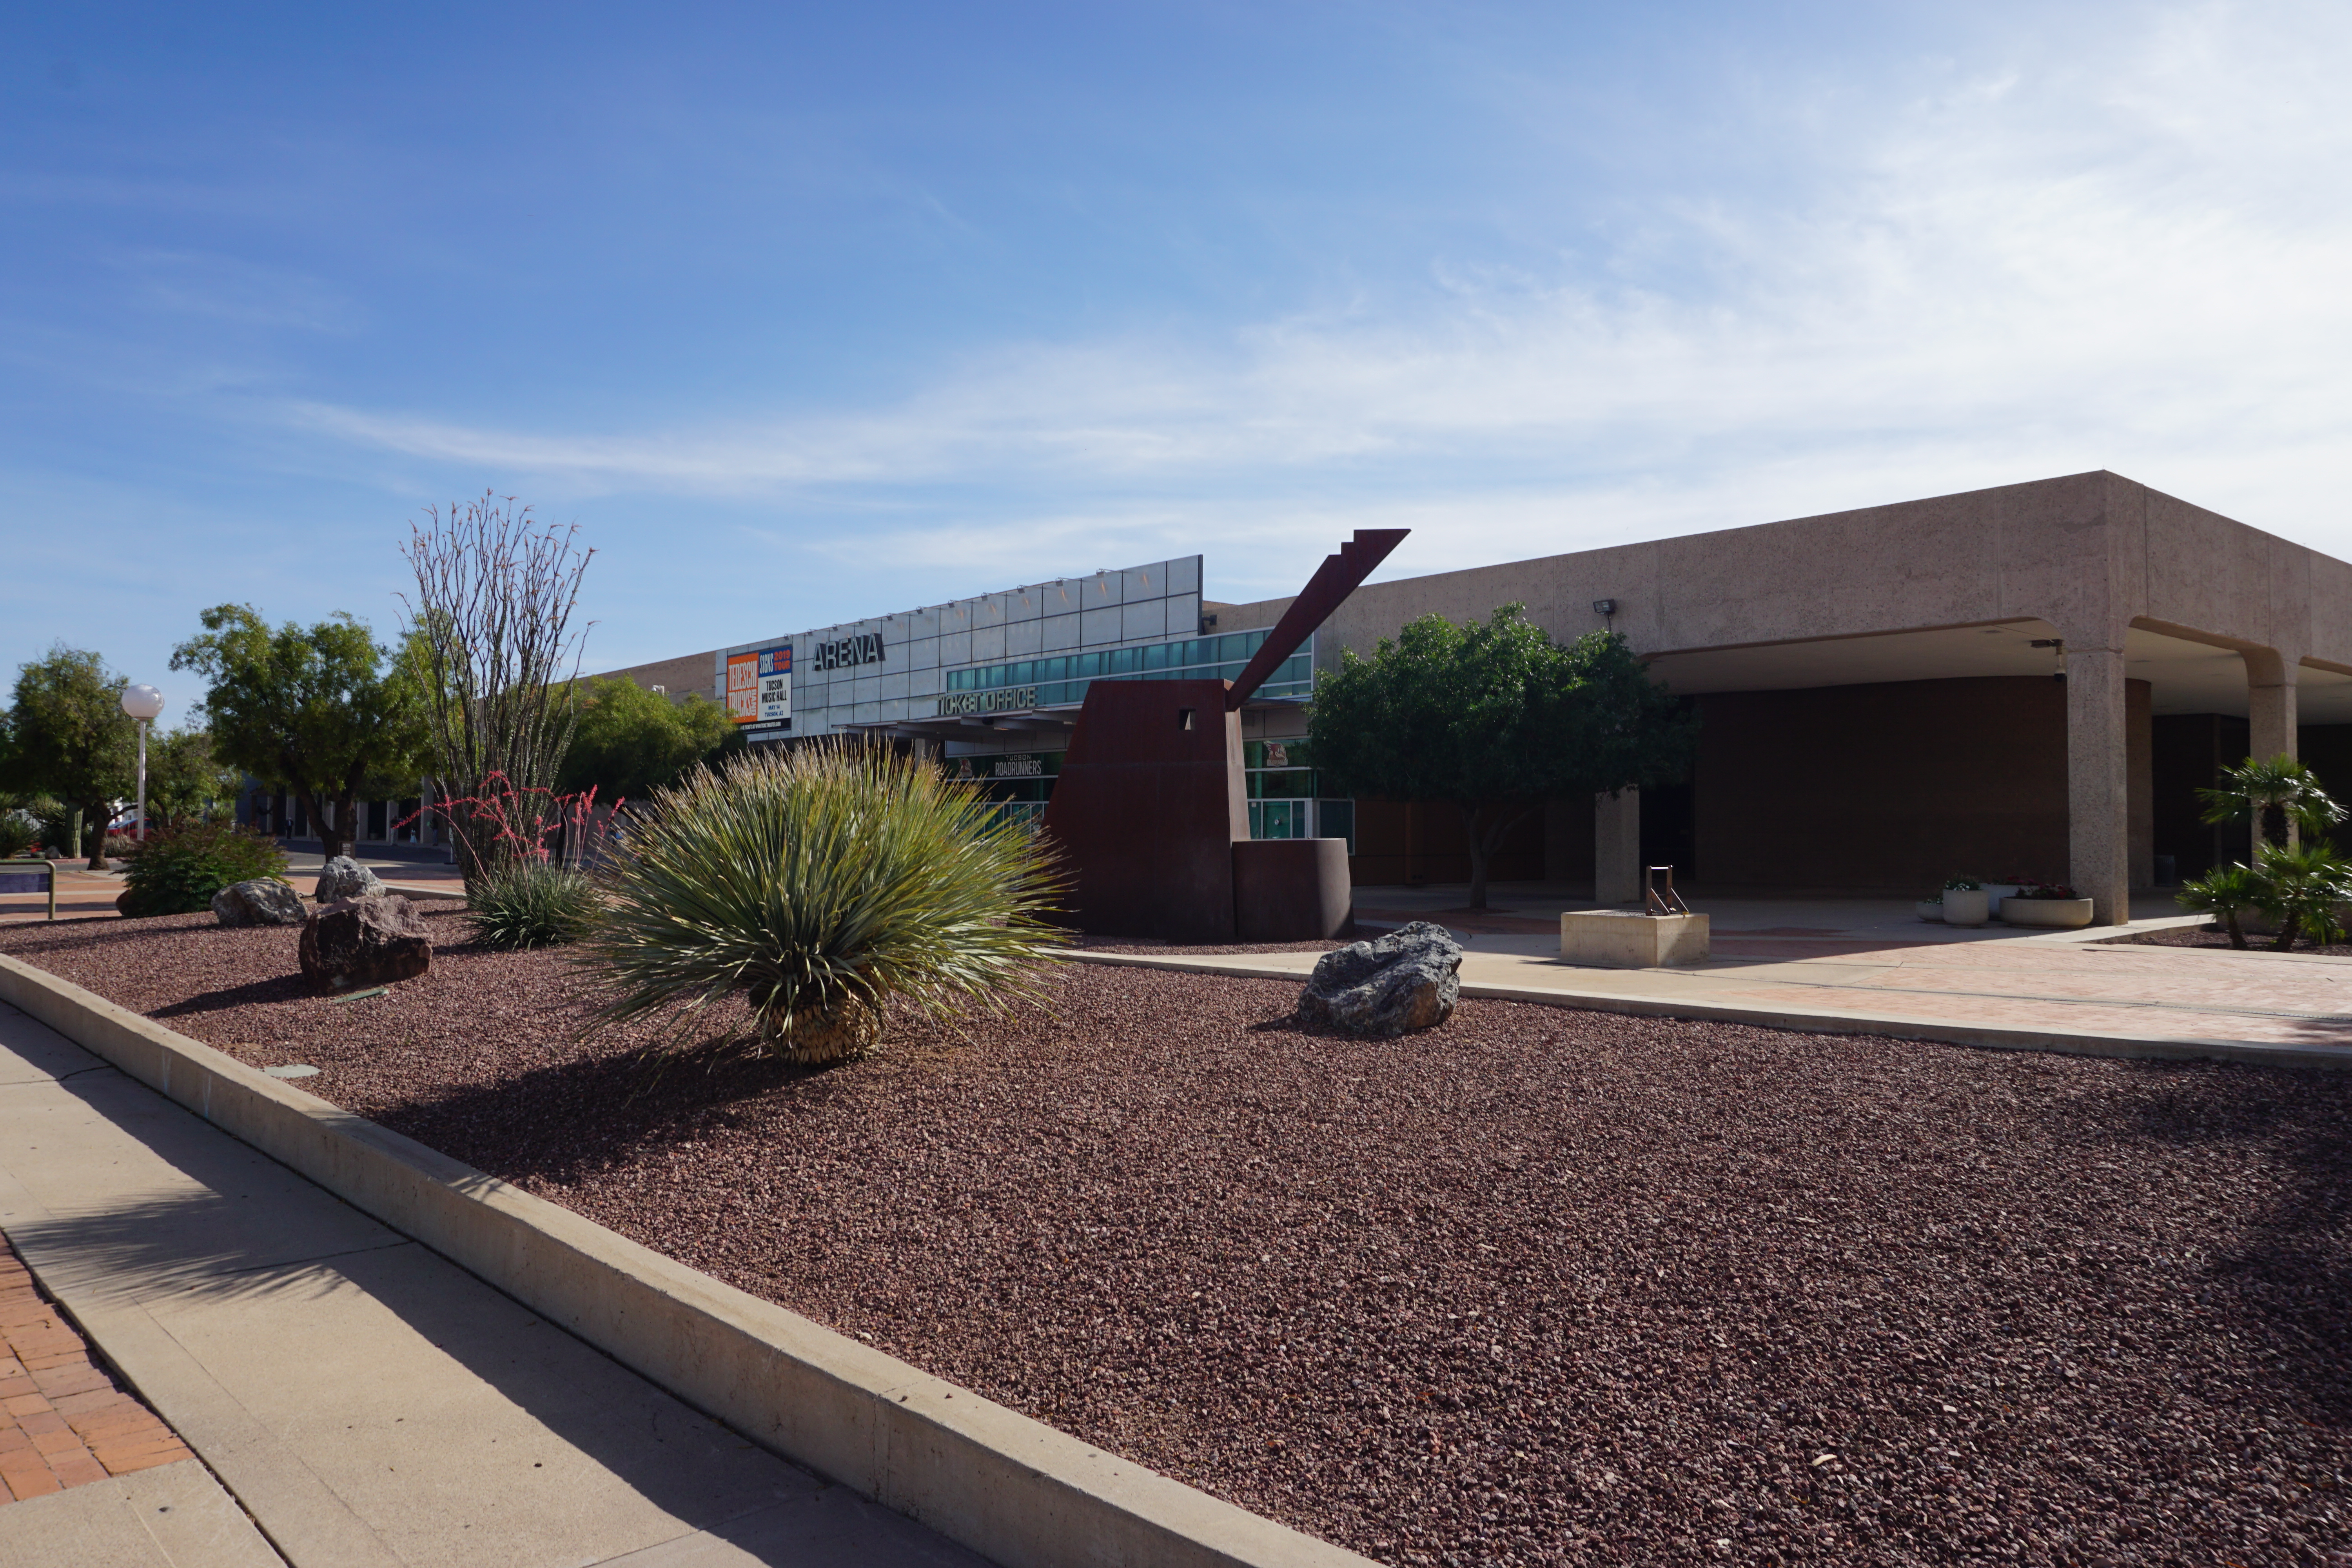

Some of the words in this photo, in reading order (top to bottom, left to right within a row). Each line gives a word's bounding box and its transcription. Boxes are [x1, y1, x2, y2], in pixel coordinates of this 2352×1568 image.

[774, 649, 791, 661] 2019
[812, 633, 880, 671] ARENA
[760, 653, 773, 674] SIGNS
[774, 660, 791, 671] TOUR
[728, 661, 757, 691] TEDESCHI
[766, 679, 783, 691] TUCSON
[728, 689, 752, 718] TRUCKS
[762, 691, 776, 704] MUSIC
[777, 690, 787, 701] HALL
[936, 692, 981, 715] TICKET
[986, 686, 1036, 711] OFFICE
[995, 760, 1042, 777] ROADRUNNERS
